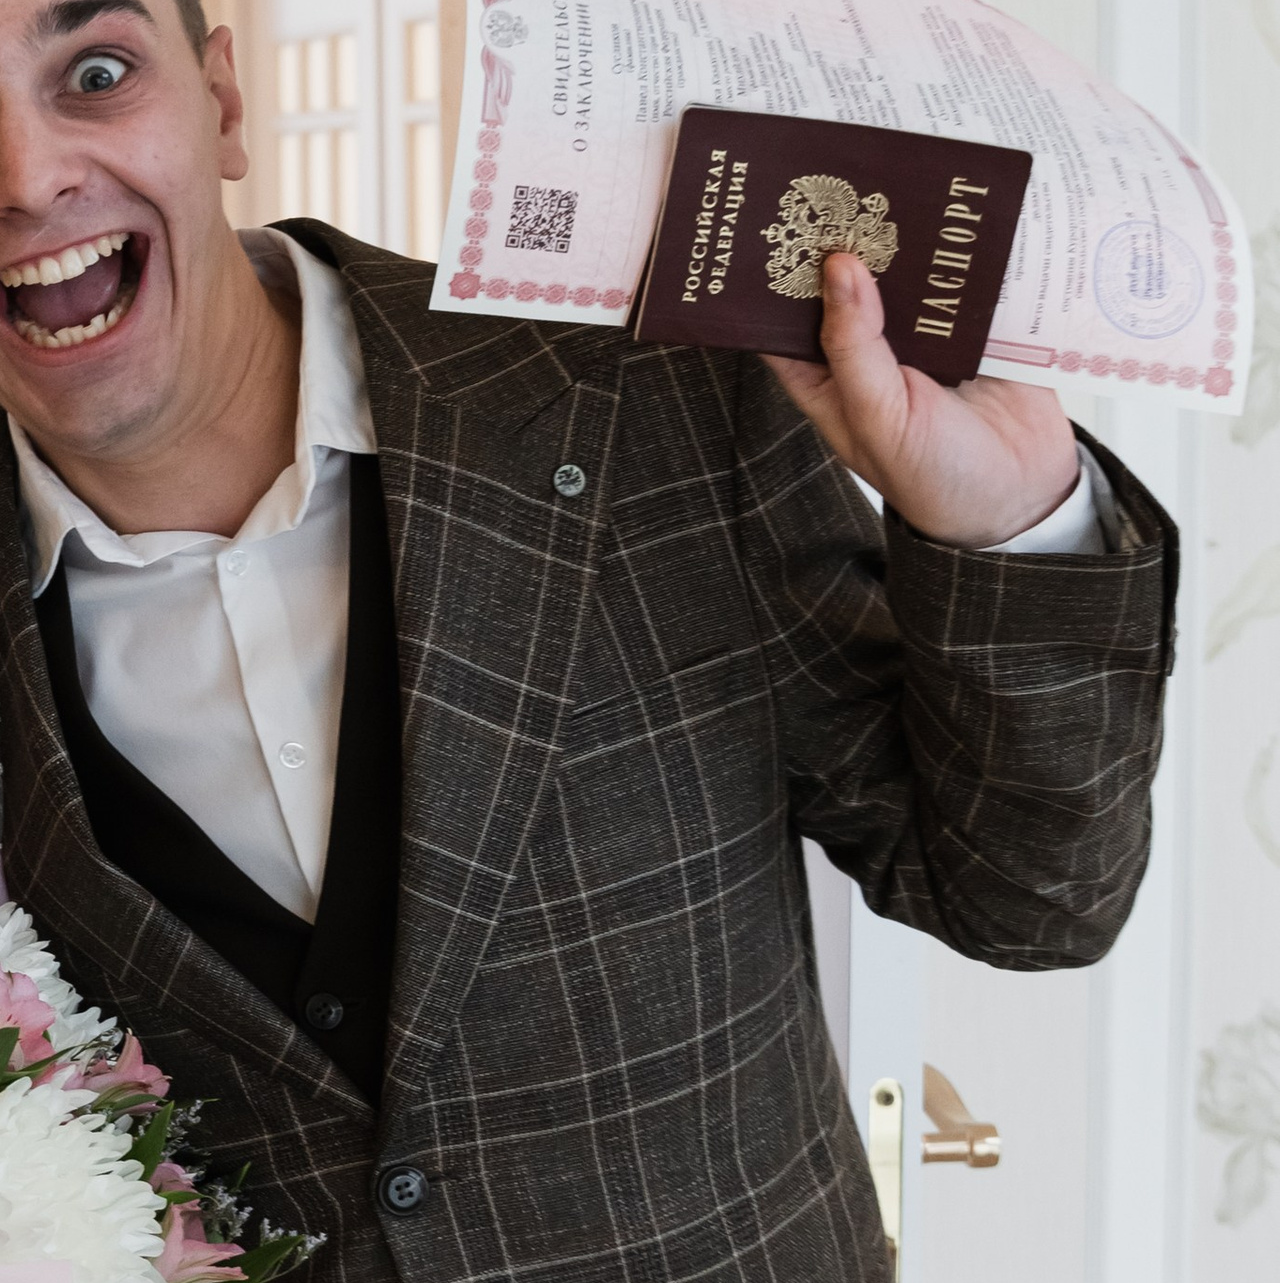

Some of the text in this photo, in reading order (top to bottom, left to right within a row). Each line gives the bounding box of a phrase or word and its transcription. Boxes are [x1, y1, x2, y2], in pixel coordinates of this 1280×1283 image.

[574, 4, 593, 132] ЗАКЛЮЧЕНИИ
[635, 85, 648, 123] Павел
[572, 138, 588, 152] О
[681, 149, 727, 303] РОССИЙСКАЯ
[707, 161, 749, 295] ФЕДЕРАЦИЯ
[914, 176, 989, 339] ПАСПОРТ
[1028, 303, 1044, 335] Место
[1039, 258, 1051, 300] выдачи
